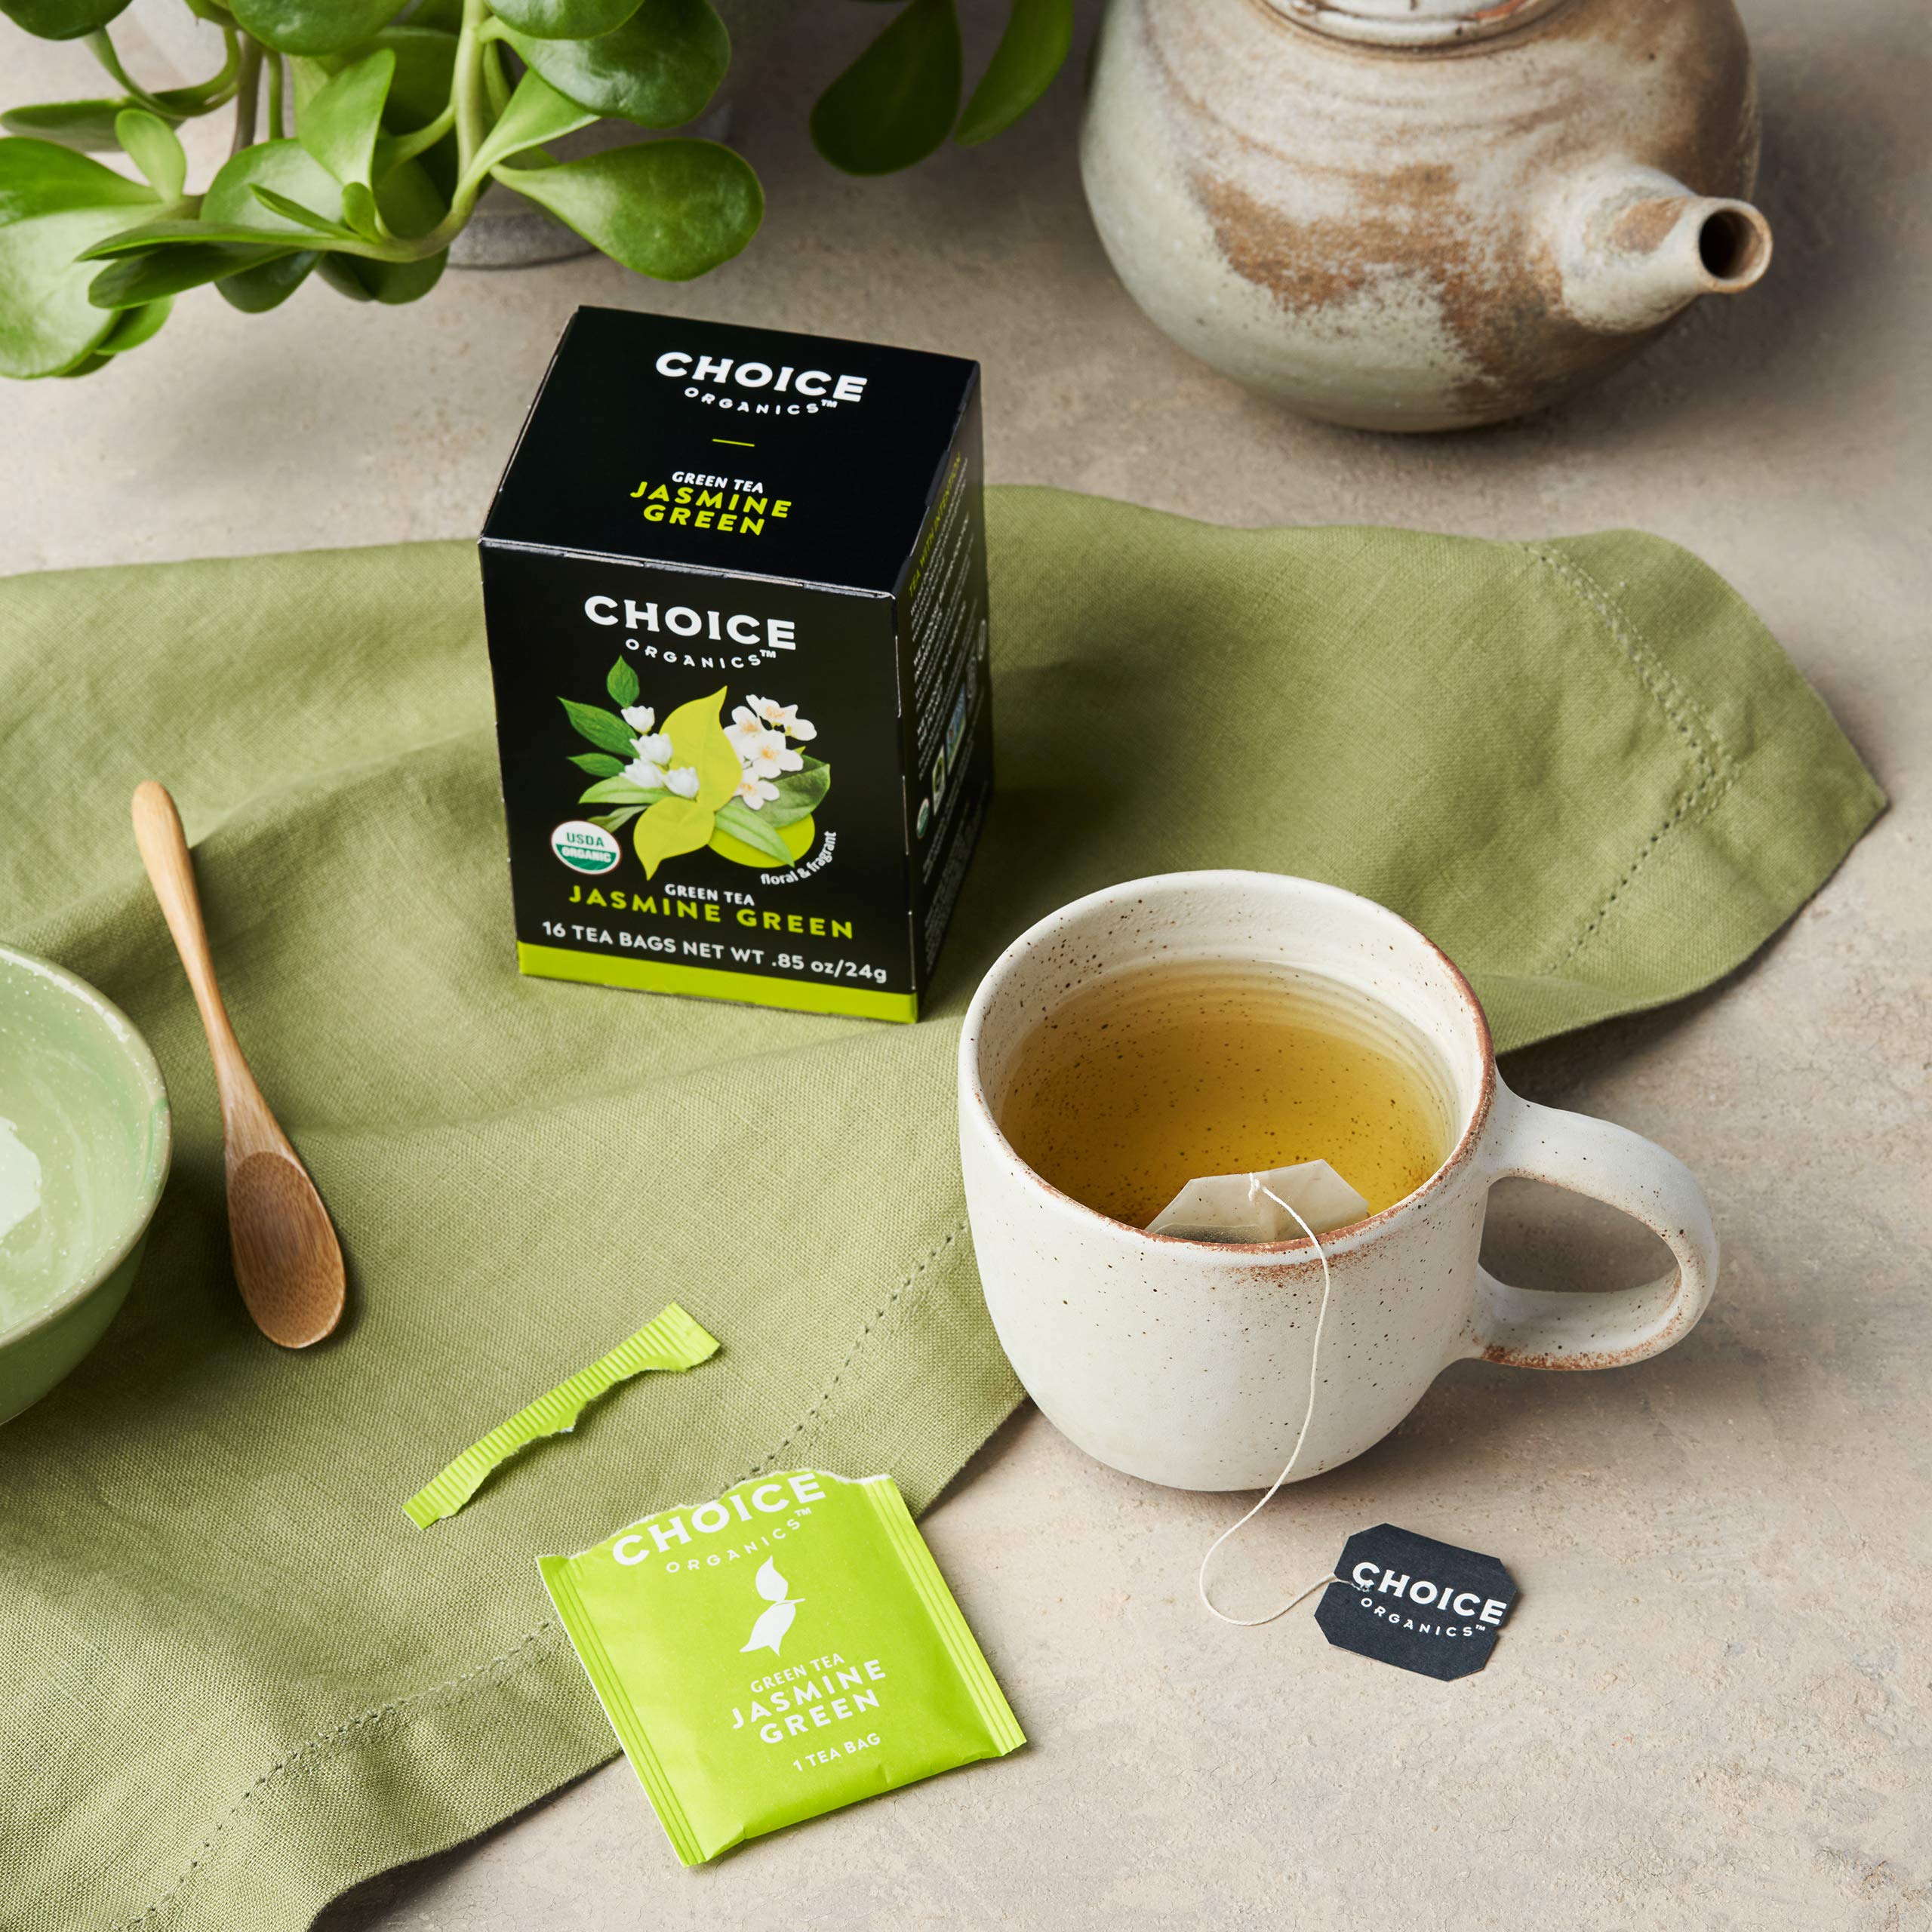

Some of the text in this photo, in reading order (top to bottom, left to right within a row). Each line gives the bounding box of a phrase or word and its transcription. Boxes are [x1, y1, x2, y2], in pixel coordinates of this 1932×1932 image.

[655, 351, 868, 401] CHOICE
[630, 481, 792, 518] JASMINE
[672, 470, 764, 494] GREEN TEA
[643, 505, 765, 536] GREEN
[584, 595, 797, 651] CHOICE
[561, 845, 612, 863] ORGANIC
[567, 832, 605, 847] USDA
[761, 830, 837, 885] floral & fragrant
[568, 885, 854, 940] JASMINE GREEN
[664, 884, 755, 906] GREEN TEA
[542, 921, 888, 984] 16 TEA BAGS NET WT .85 oz/24g
[613, 1472, 826, 1566] CHOICE
[1352, 1561, 1507, 1625] CHOICE
[732, 1659, 887, 1730] JASMINE
[750, 1653, 846, 1694] GREEN TEA
[759, 1689, 881, 1745] GREEN
[792, 1733, 881, 1773] 1 TEA BAG
